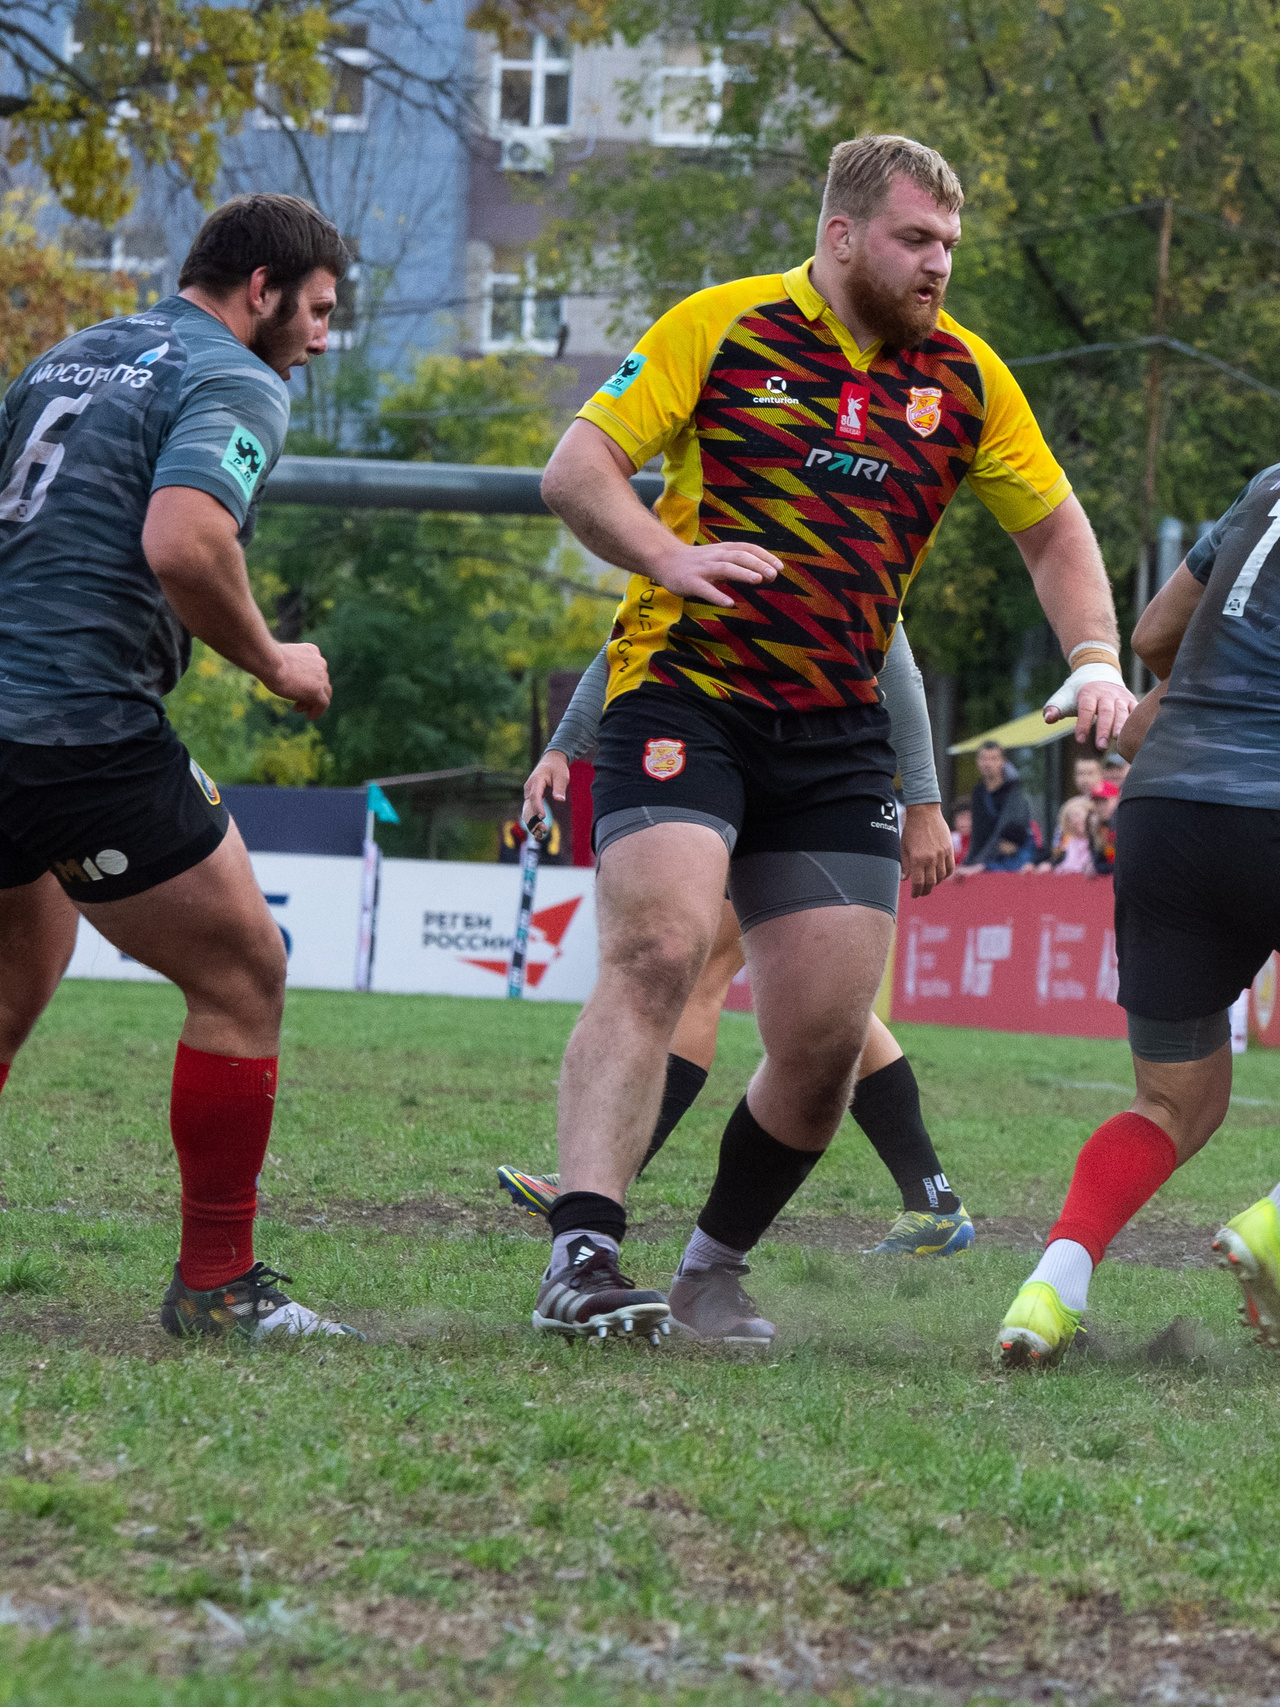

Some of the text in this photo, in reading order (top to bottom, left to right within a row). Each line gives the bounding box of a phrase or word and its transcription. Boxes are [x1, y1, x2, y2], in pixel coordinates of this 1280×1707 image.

[753, 397, 799, 405] centurion
[0, 392, 94, 523] 6
[805, 447, 889, 483] PARI
[423, 910, 492, 930] РЕГБИ
